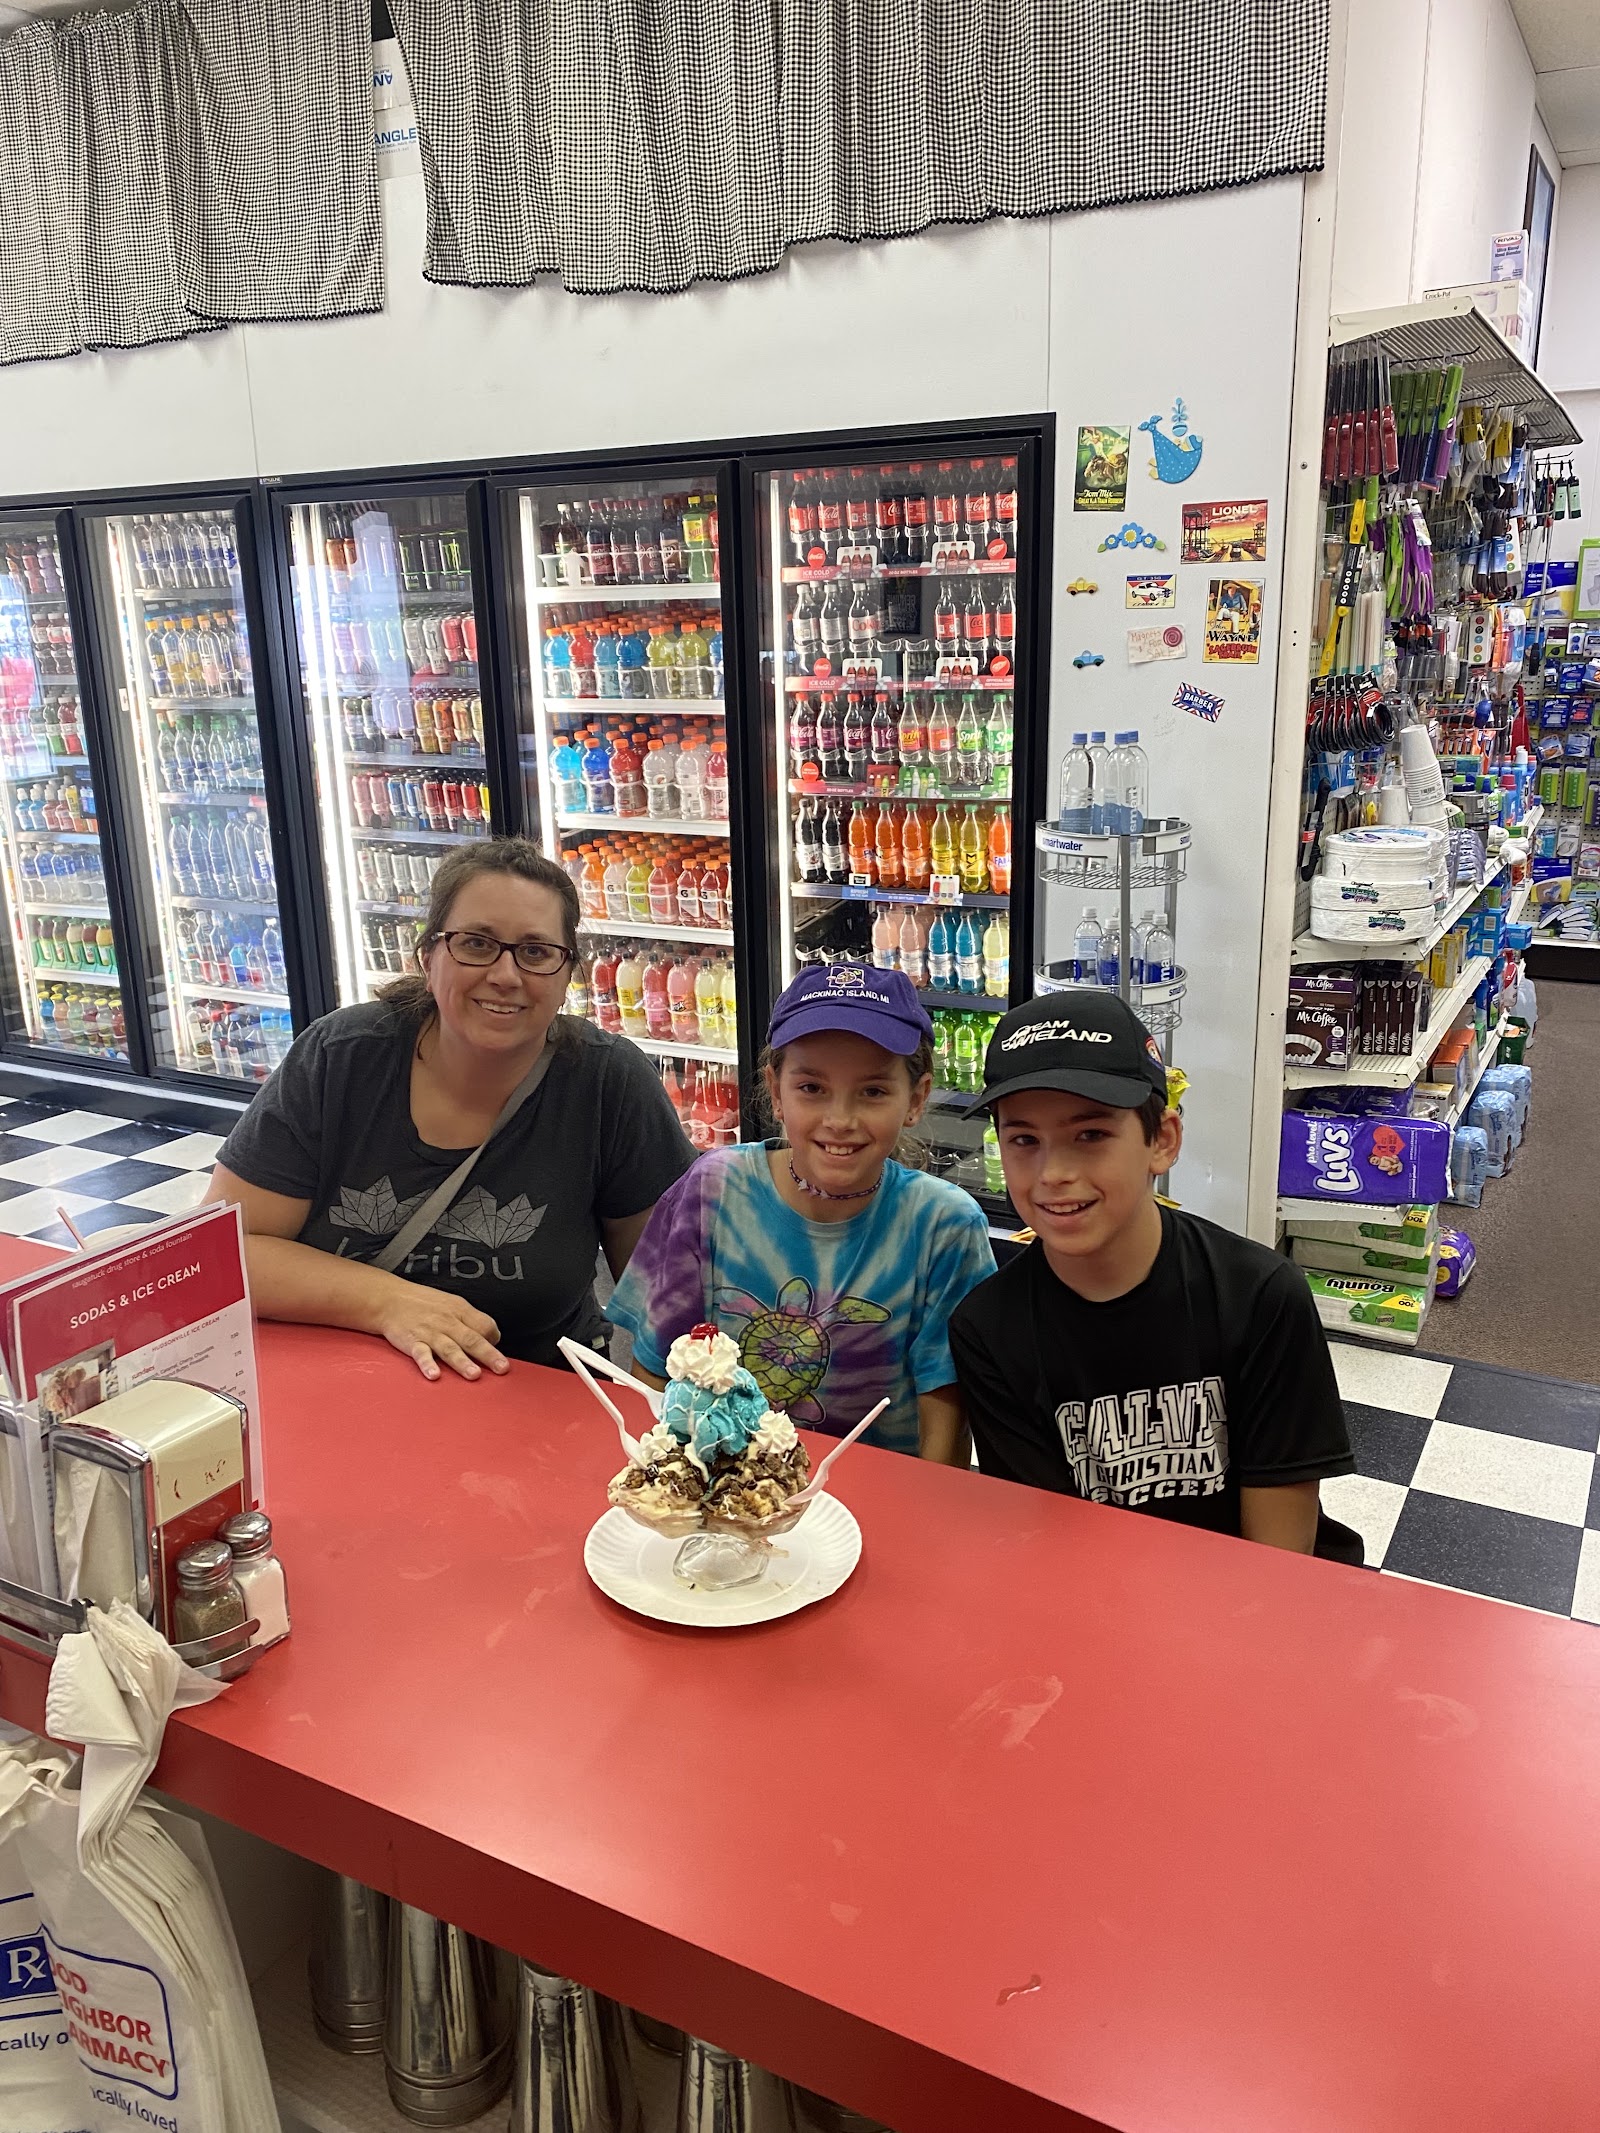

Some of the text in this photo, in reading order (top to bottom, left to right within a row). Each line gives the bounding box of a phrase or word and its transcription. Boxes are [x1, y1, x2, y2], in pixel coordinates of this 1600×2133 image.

[1212, 504, 1258, 516] LIONEL
[1131, 630, 1161, 643] Magnets
[1208, 630, 1255, 642] WAYNE
[1147, 647, 1176, 658] SALE
[1183, 692, 1214, 712] BARBER
[1042, 836, 1083, 852] smartwater
[1316, 979, 1334, 991] Coffee
[800, 989, 890, 1003] MACKINAC ISLAND, MI
[1026, 1020, 1070, 1032] TEAM
[1311, 1011, 1337, 1027] Coffee
[1009, 1029, 1113, 1051] WIELAND
[106, 1262, 123, 1275] drug
[142, 1251, 148, 1259] &
[149, 1245, 165, 1256] soda
[165, 1232, 193, 1249] fountain
[1325, 1278, 1396, 1293] Bounty
[70, 1261, 201, 1329] SODAS & ICE CREAM
[1398, 1300, 1415, 1308] 100
[191, 1325, 200, 1334] ICE
[201, 1316, 220, 1329] CREAM
[1095, 1451, 1217, 1488] CHRISTIAN
[60, 1990, 154, 2046] IGHBOR
[0, 2031, 50, 2051] cally
[68, 2020, 168, 2078] ARMACY
[135, 2101, 178, 2133] loved
